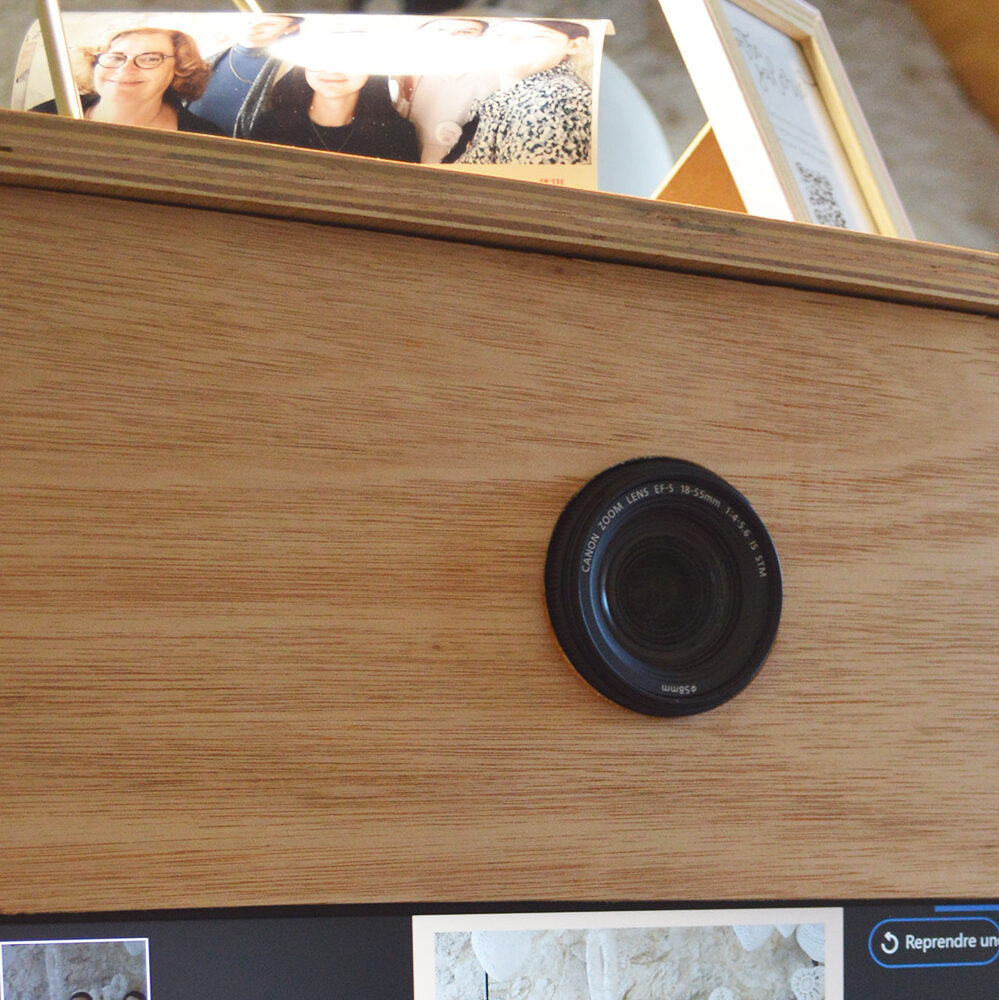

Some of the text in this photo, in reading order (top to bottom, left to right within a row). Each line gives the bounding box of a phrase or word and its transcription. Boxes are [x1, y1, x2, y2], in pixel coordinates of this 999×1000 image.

[626, 488, 649, 504] LENS
[654, 483, 675, 494] EF-S
[681, 485, 721, 508] 18-55mm
[598, 502, 624, 531] ZOOM
[582, 532, 600, 573] CANON
[749, 540, 760, 551] IS
[754, 555, 768, 578] STM
[905, 932, 977, 953] Reprendre
